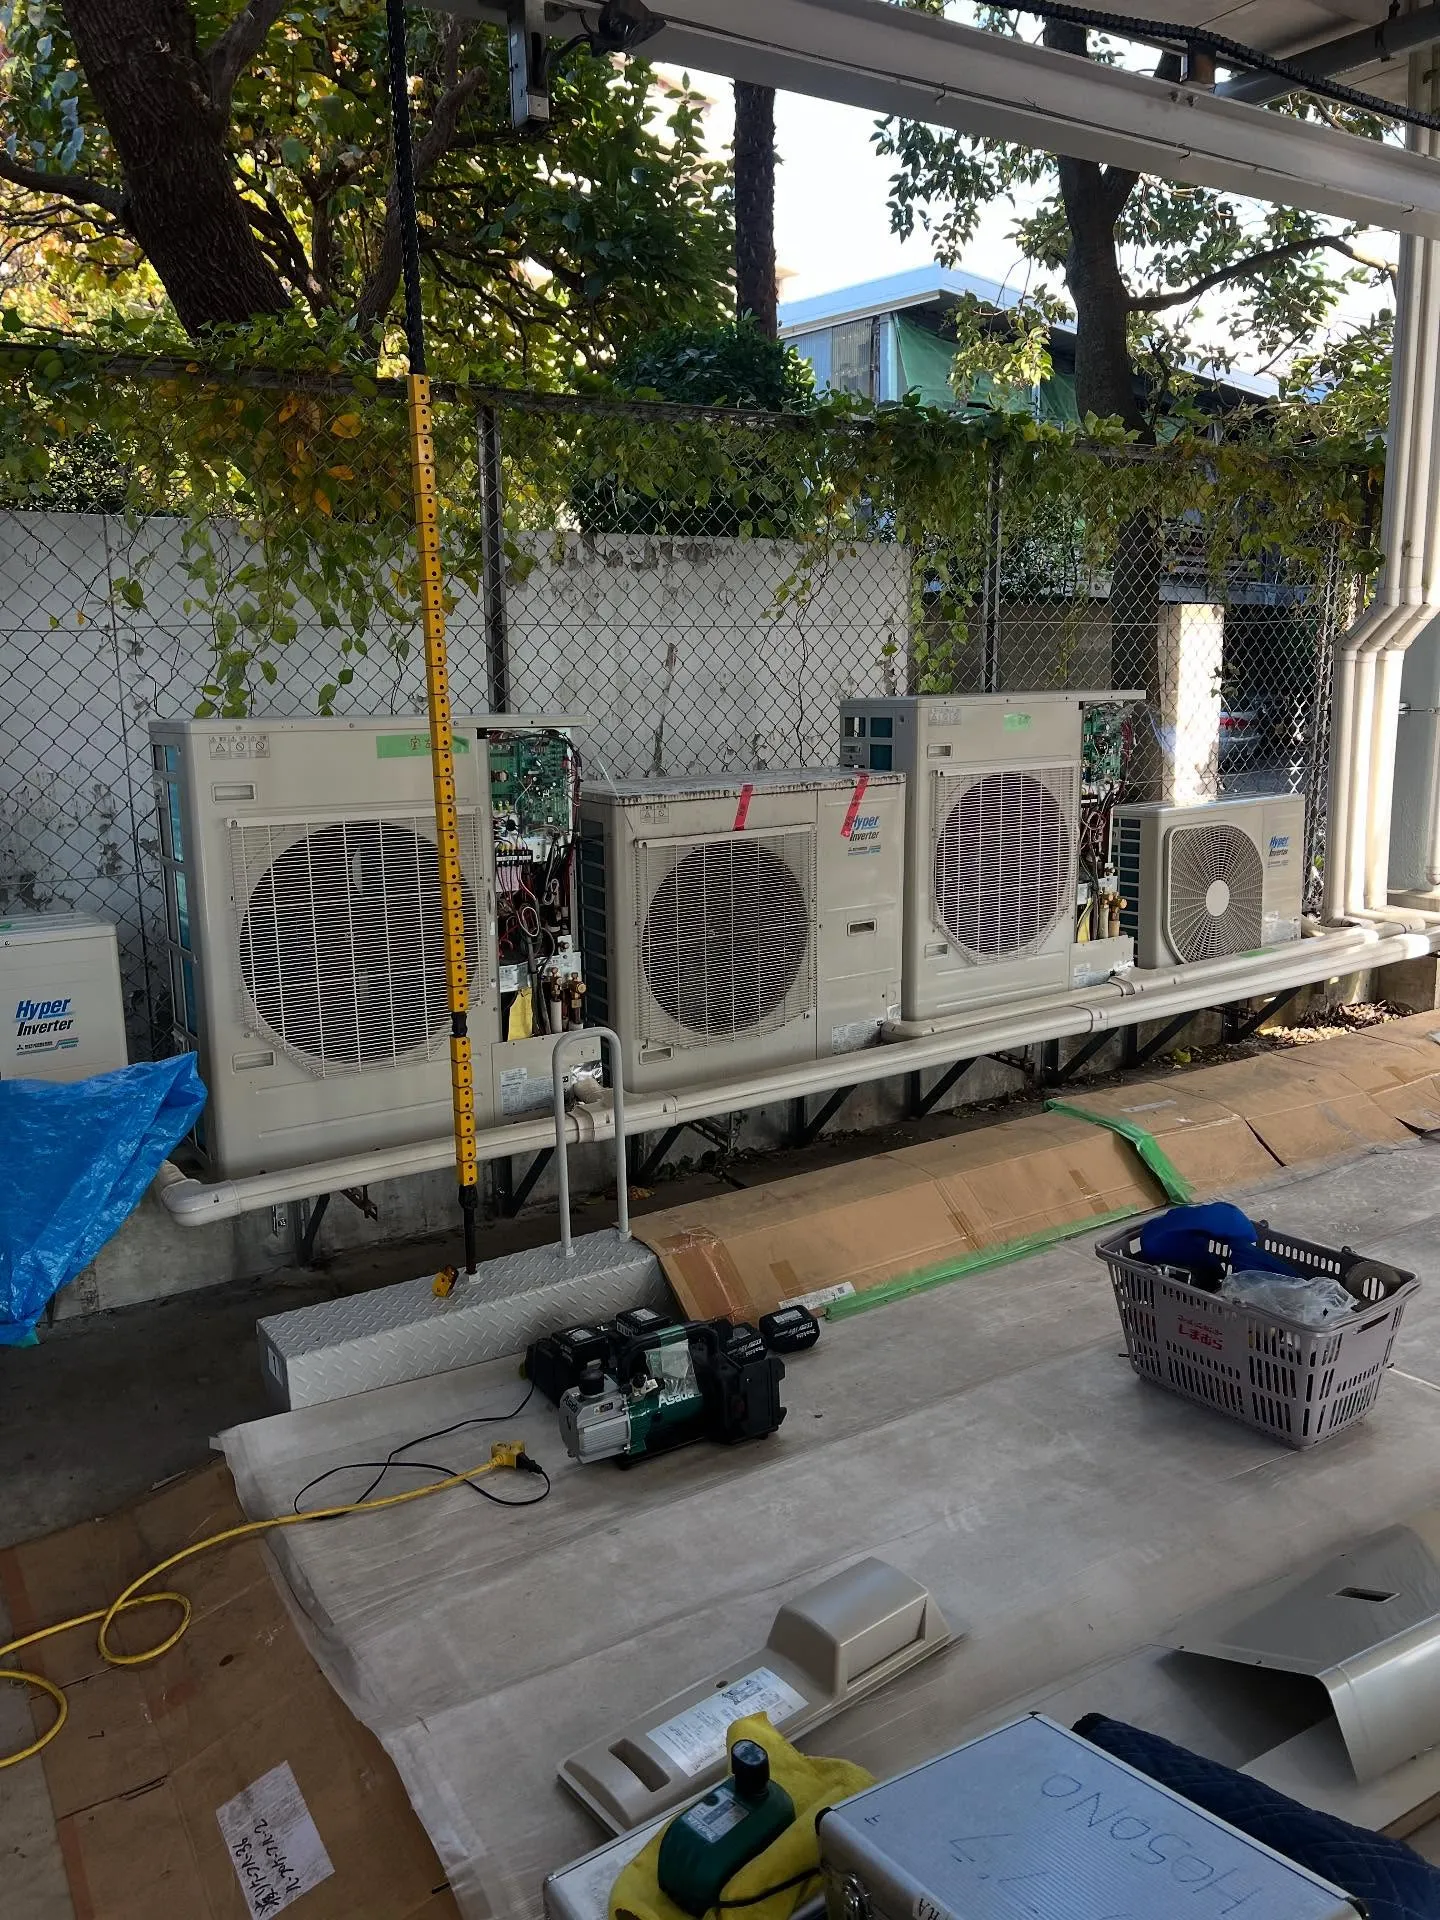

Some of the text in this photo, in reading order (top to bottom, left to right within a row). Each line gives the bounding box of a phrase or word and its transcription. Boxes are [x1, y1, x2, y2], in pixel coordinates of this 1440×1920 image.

[850, 831, 880, 841] Inverter
[16, 998, 72, 1020] Hyper
[17, 1020, 74, 1036] Inverter
[1041, 1773, 1261, 1915] HOSONO
